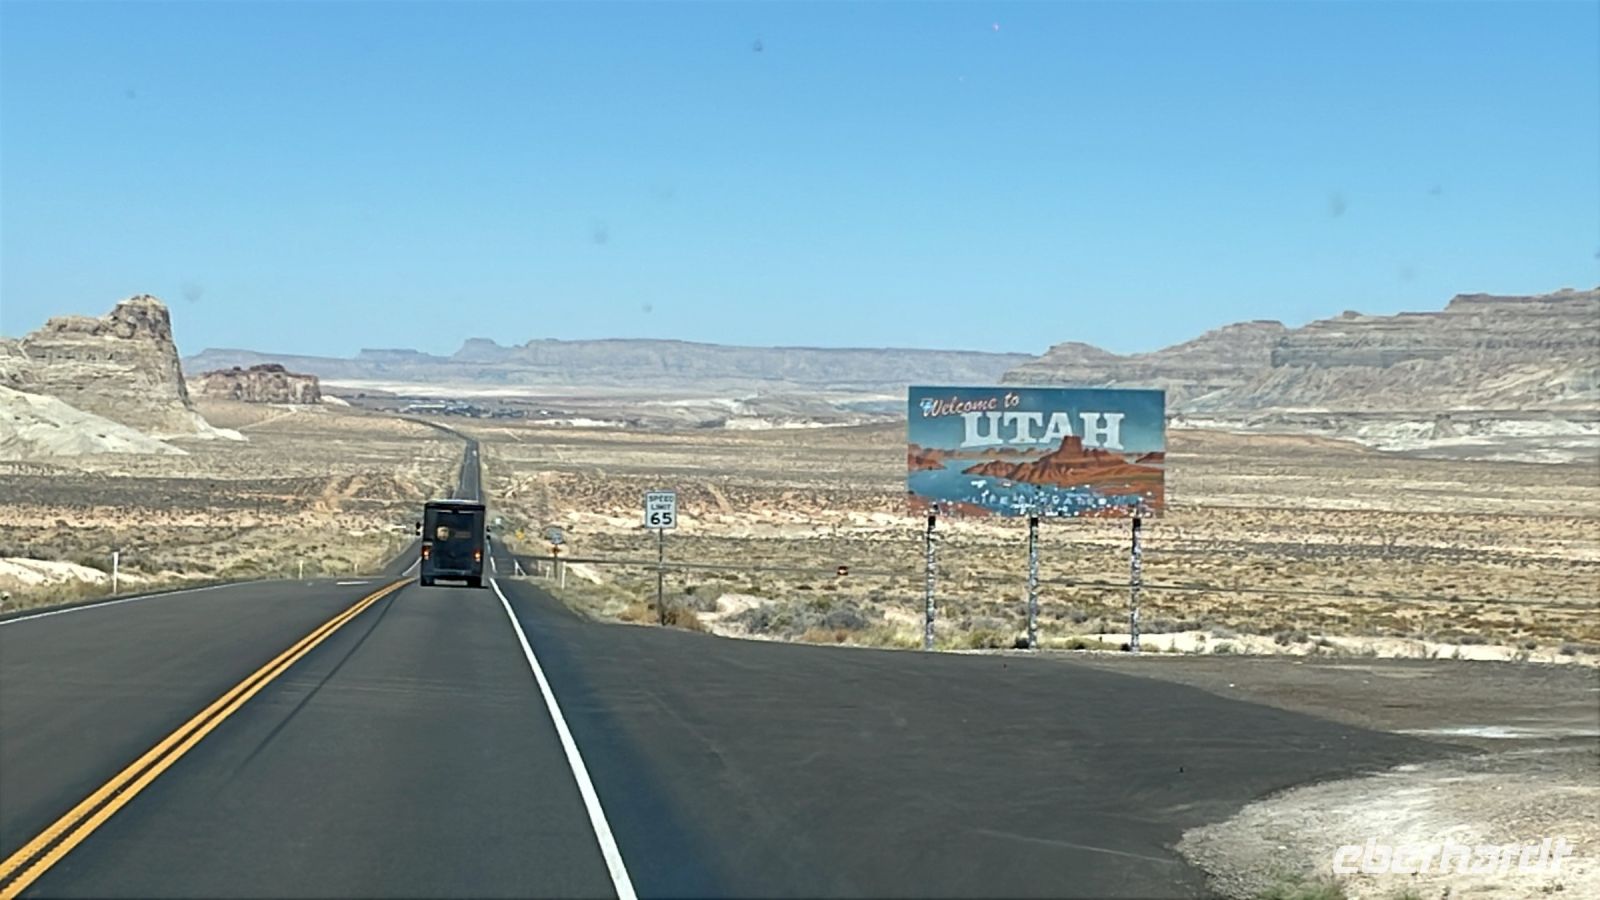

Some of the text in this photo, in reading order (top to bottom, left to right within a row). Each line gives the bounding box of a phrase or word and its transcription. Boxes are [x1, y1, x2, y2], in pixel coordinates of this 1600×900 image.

[922, 392, 1020, 417] Welcome to
[960, 411, 1126, 449] UTAH
[650, 512, 672, 525] 65
